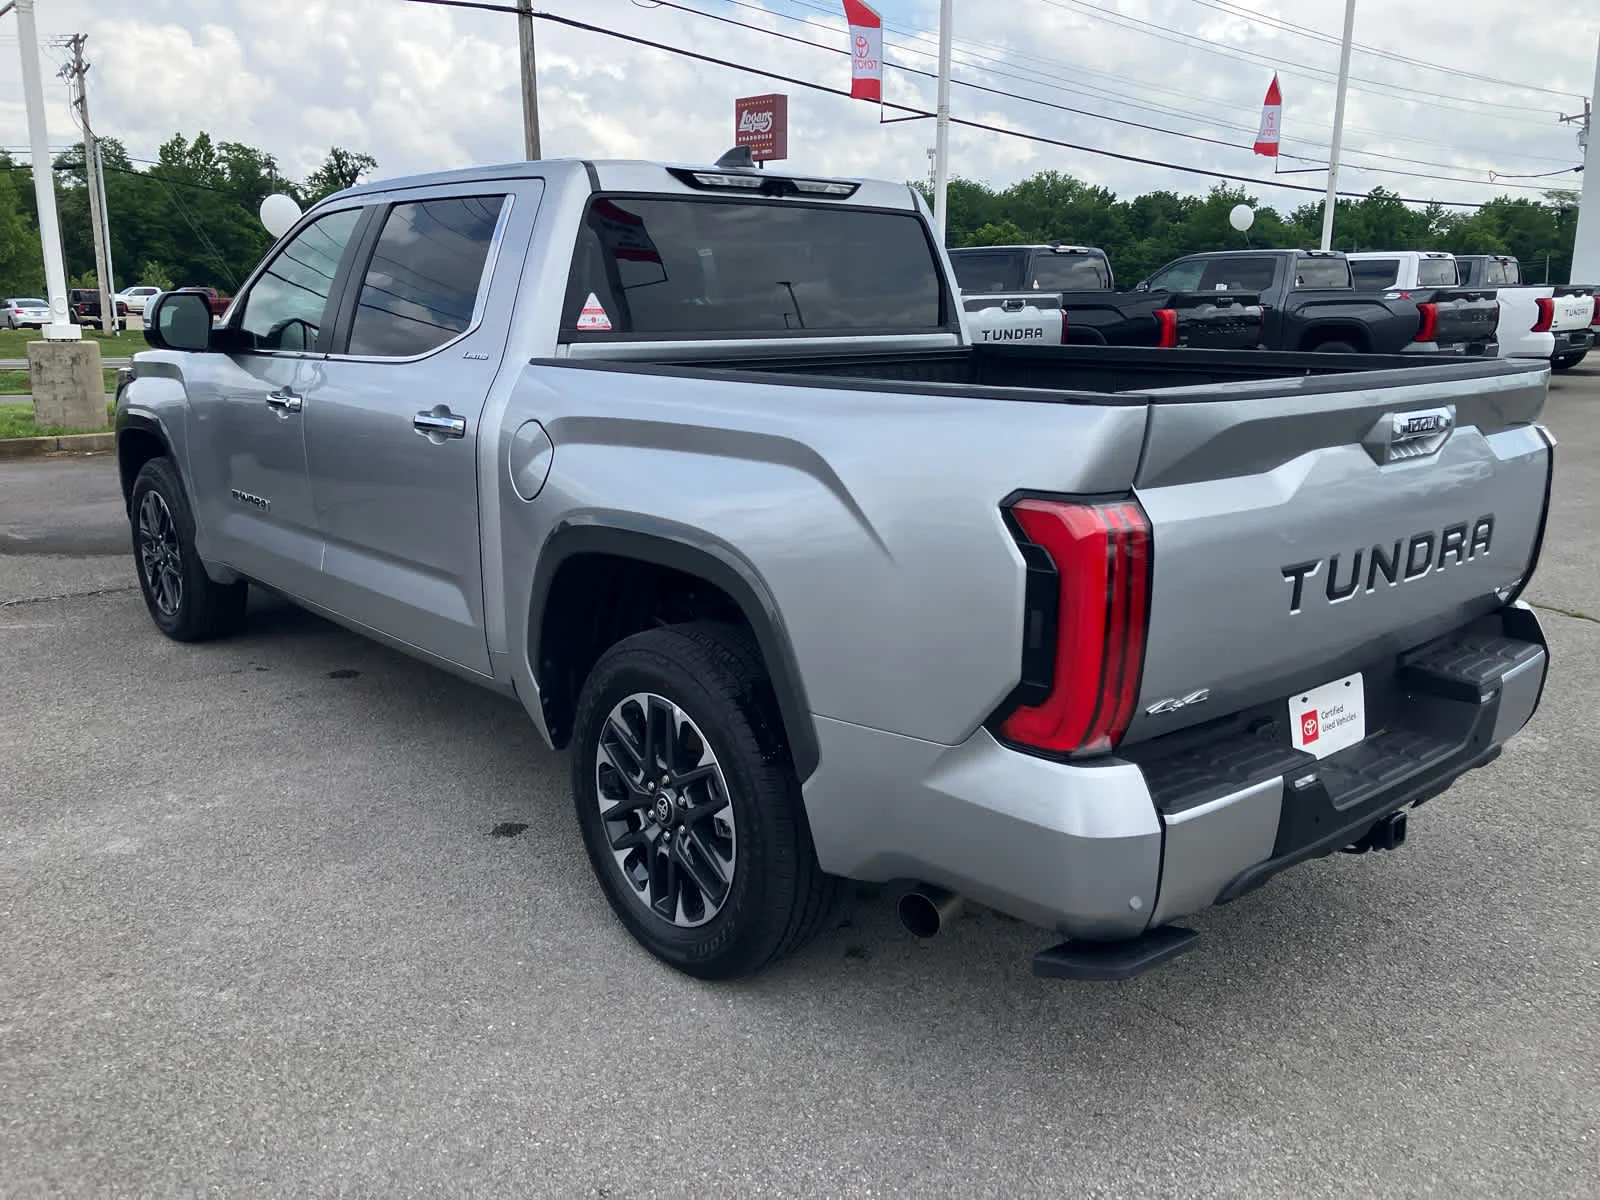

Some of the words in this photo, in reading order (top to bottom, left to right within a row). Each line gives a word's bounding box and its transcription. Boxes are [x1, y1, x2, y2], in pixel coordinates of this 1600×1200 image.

[981, 327, 1043, 341] TUNDRA
[1281, 513, 1495, 616] TUNDRA
[1321, 704, 1344, 719] Certified
[1322, 721, 1336, 732] Used
[1336, 713, 1357, 726] Vehicles
